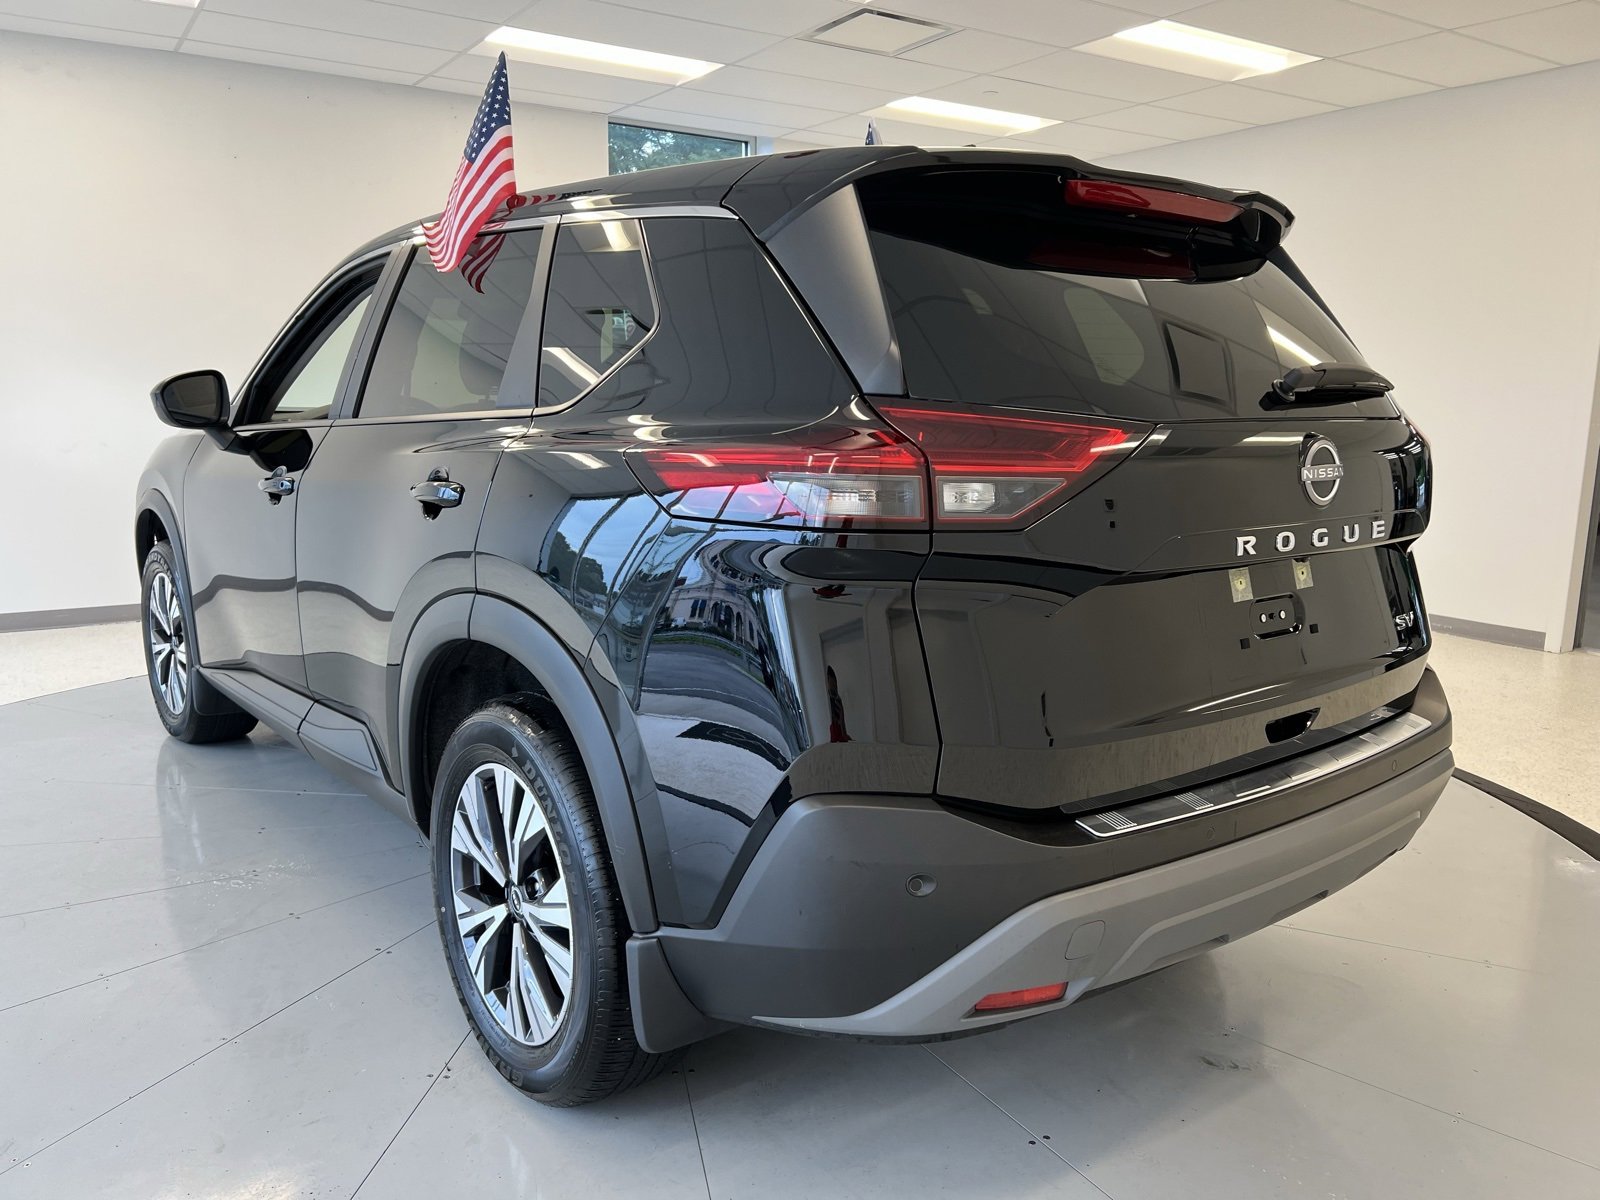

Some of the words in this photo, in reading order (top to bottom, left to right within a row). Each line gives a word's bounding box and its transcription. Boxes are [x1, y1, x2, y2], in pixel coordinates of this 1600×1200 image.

[1303, 467, 1343, 479] NISSAN
[1236, 520, 1385, 557] ROGUE
[1395, 611, 1414, 630] SV
[522, 759, 578, 895] DUNLOP
